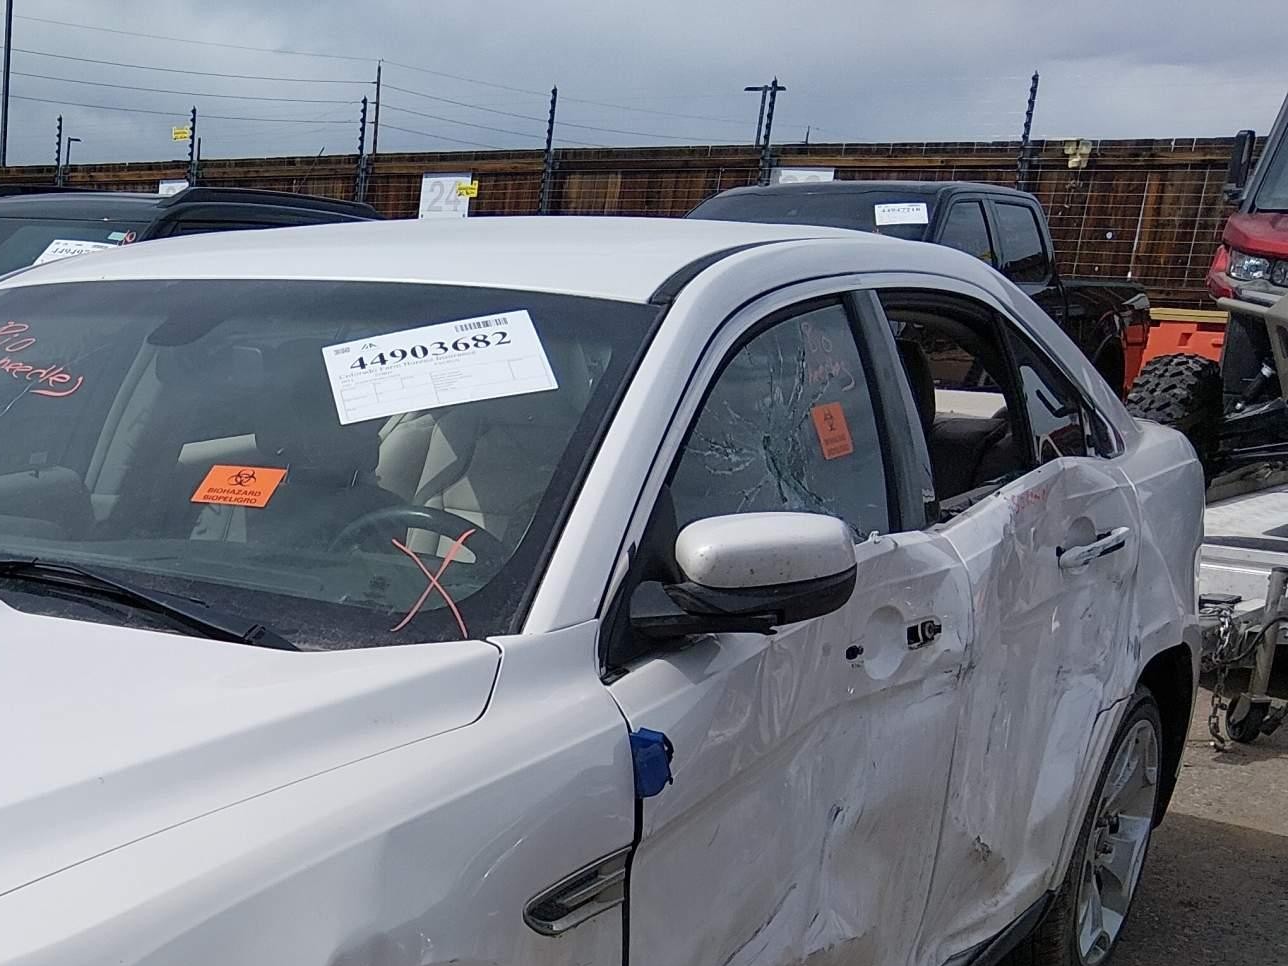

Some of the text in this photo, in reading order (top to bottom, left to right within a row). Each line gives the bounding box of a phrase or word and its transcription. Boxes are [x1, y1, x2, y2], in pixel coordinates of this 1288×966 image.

[426, 180, 460, 212] 24
[349, 331, 512, 371] 44903682
[202, 494, 258, 505] BIOPELIGRO
[207, 487, 262, 497] BIOHAZARD
